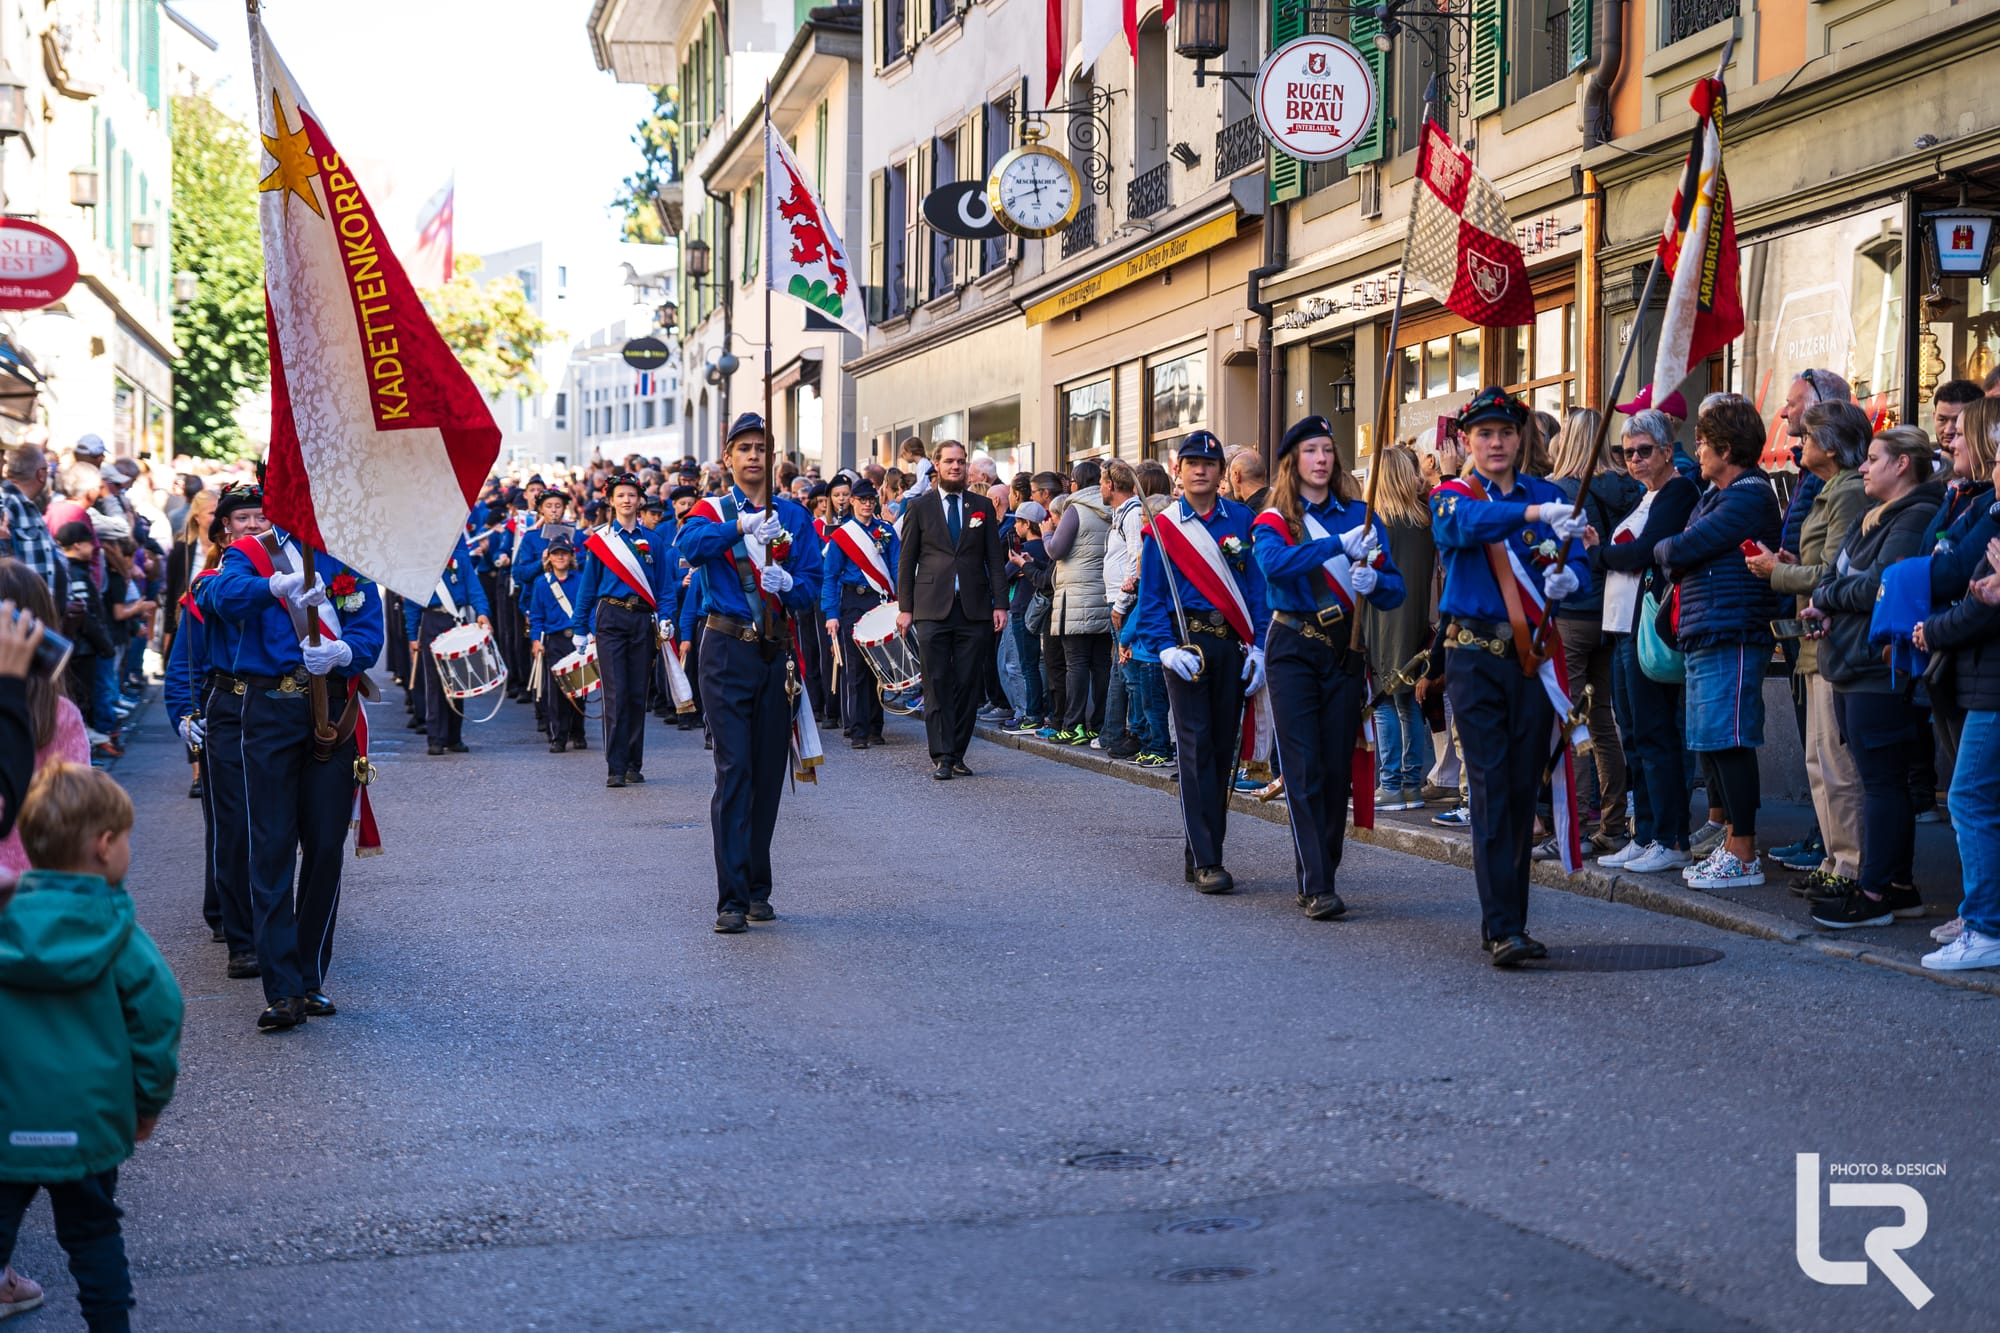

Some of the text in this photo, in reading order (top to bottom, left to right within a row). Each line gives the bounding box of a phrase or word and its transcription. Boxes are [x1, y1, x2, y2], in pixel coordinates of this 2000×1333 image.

[1287, 82, 1344, 101] RUGEN
[1286, 101, 1343, 121] BRÄU
[1295, 124, 1332, 132] INTERLAKEN
[322, 152, 409, 422] KADETTENKORPS
[1788, 331, 1838, 361] PIZZERIA
